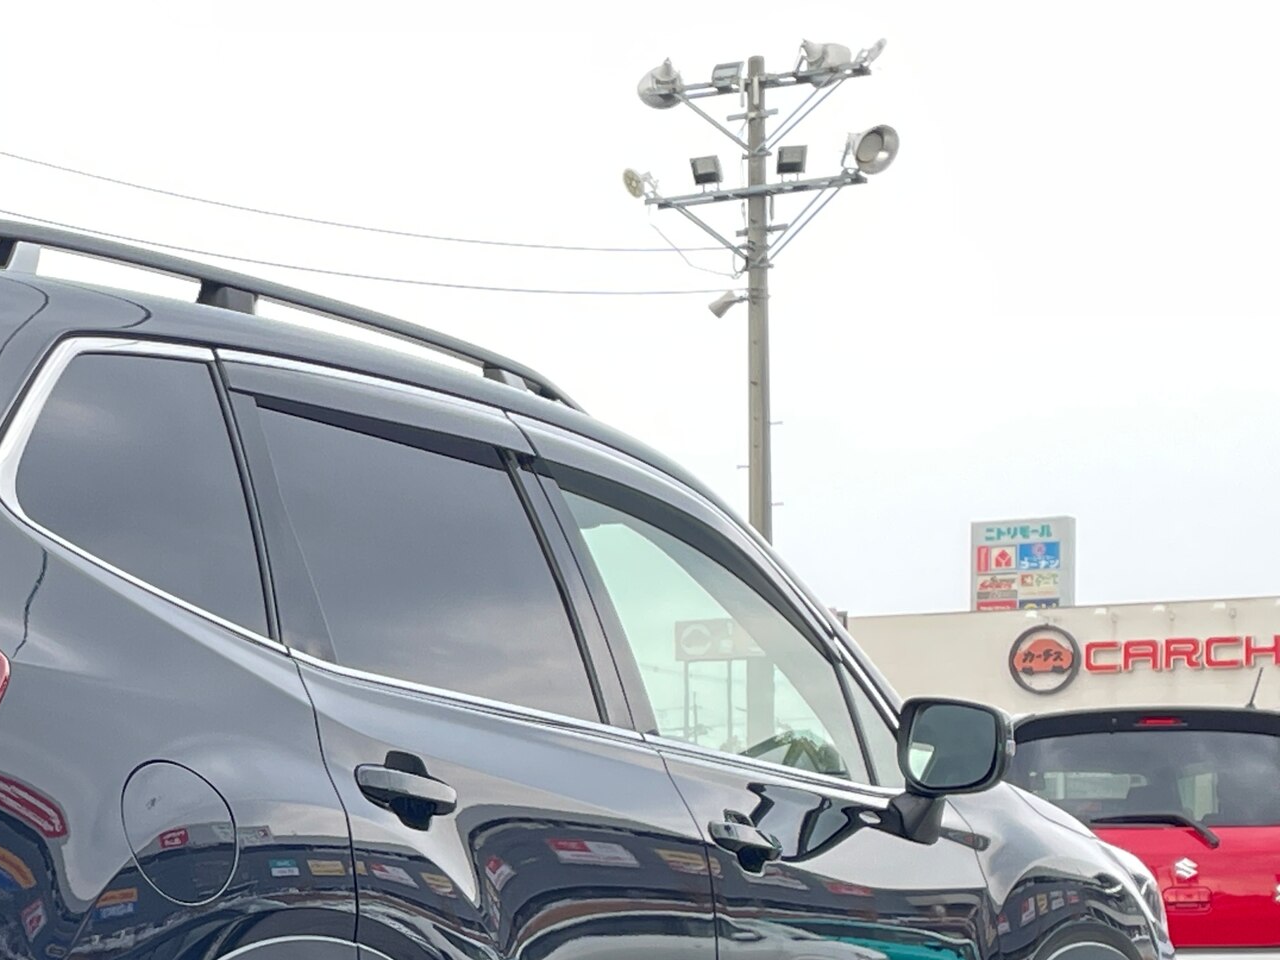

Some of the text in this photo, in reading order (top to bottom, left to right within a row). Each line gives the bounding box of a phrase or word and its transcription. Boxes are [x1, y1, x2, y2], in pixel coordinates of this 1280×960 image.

[984, 524, 1053, 541] ニトリモール
[1022, 648, 1064, 663] カーチス
[1084, 635, 1280, 672] CARCH
